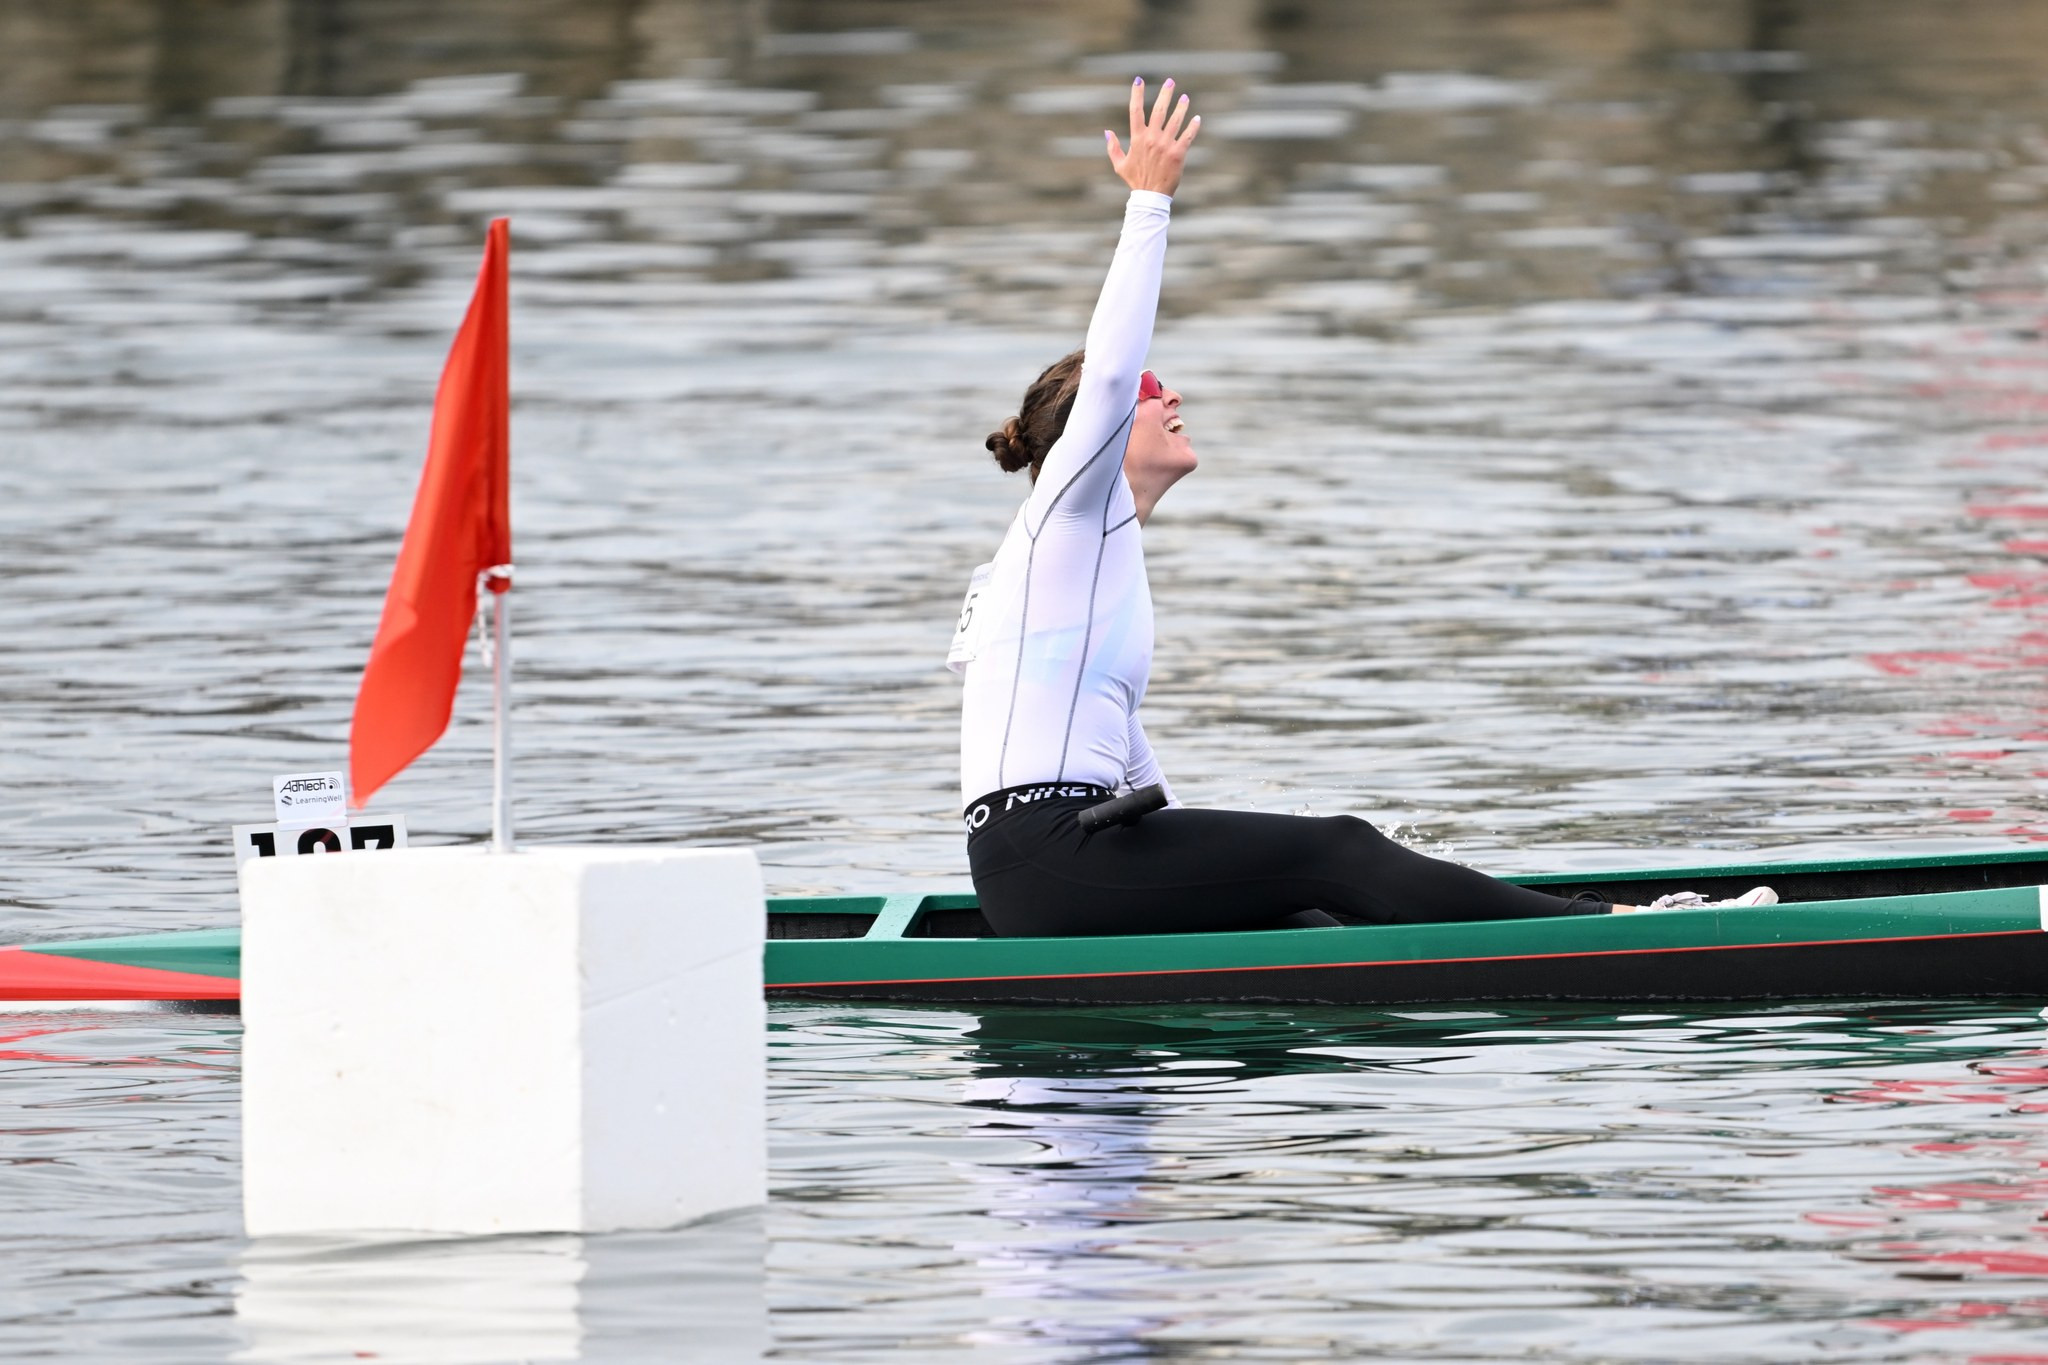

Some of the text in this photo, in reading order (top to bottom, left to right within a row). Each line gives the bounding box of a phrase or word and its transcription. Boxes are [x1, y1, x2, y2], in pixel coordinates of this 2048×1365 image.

[959, 593, 978, 633] 5
[280, 778, 326, 793] AdhTech
[295, 794, 342, 805] LearningWell
[965, 786, 1086, 834] RO NIKE
